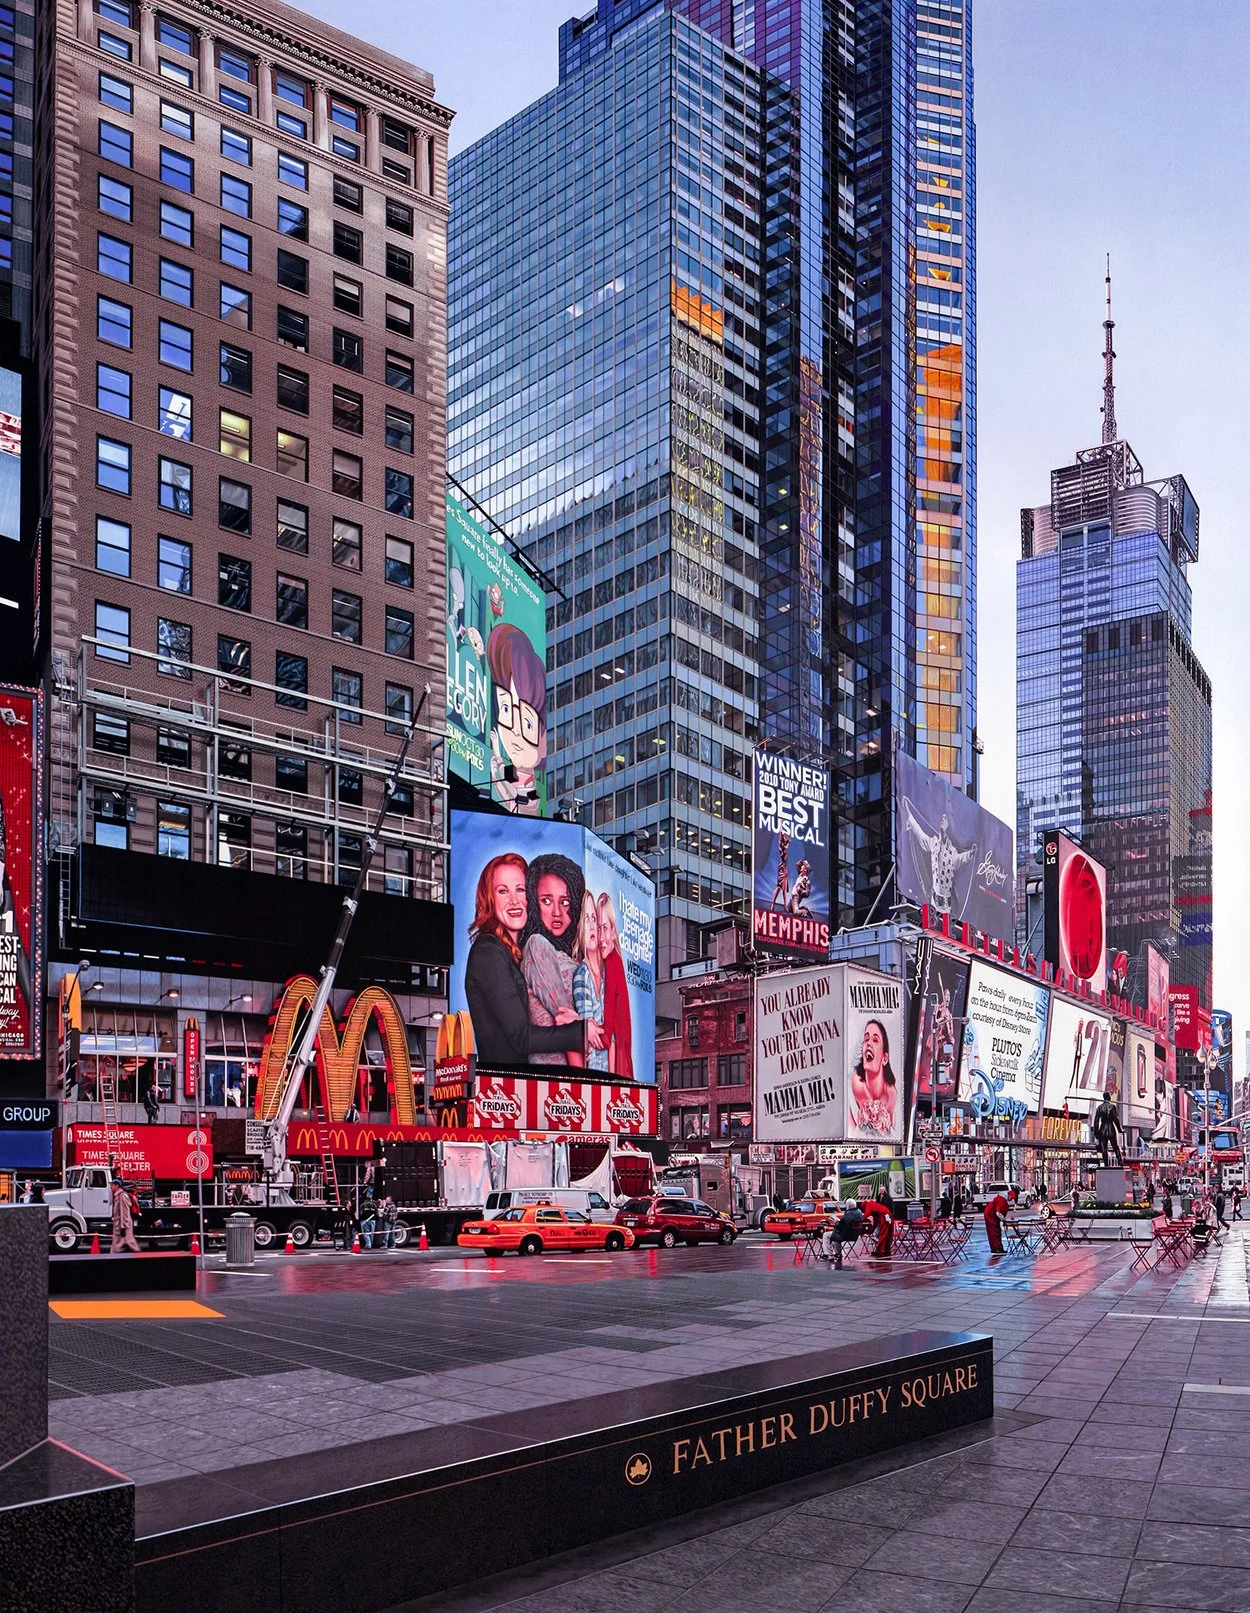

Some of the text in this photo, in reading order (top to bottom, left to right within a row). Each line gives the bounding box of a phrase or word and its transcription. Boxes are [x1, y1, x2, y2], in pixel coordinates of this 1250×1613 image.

[455, 509, 481, 543] Square
[482, 535, 502, 567] finally
[503, 556, 514, 577] has
[515, 574, 540, 606] someone
[461, 534, 475, 552] new
[477, 546, 485, 561] to
[486, 553, 501, 577] look
[502, 574, 511, 590] up
[446, 723, 461, 743] SUN
[755, 750, 828, 790] WINNER!
[758, 770, 824, 802] 2010 TONY AWARD
[758, 784, 824, 829] BEST
[758, 812, 824, 847] MUSICAL
[1046, 857, 1056, 865] LG
[622, 898, 640, 921] hate
[640, 909, 652, 928] my
[623, 912, 653, 950] teenage
[754, 909, 830, 947] MEMPHIS
[619, 932, 653, 965] daughter
[627, 958, 641, 977] WED
[761, 976, 831, 1016] YOU ALREADY
[849, 985, 900, 1009] MAMMA MIA!
[971, 997, 979, 1005] on
[979, 996, 989, 1007] the
[988, 1000, 1001, 1013] hour
[1001, 1003, 1014, 1016] from
[978, 982, 1034, 1010] Paws daily every hour
[781, 1003, 814, 1031] KNOW
[972, 1012, 1031, 1035] courtesy of Disney Store
[761, 1018, 840, 1059] YOU'RE GONNA
[991, 1037, 1022, 1058] PLUTO'S
[435, 1064, 468, 1077] McDonald's
[780, 1044, 825, 1075] LOVE IT!
[990, 1054, 1019, 1071] Sidewalk
[188, 1063, 196, 1093] HOURS
[990, 1067, 1016, 1083] Cinema
[763, 1085, 806, 1117] MAMMA
[808, 1077, 835, 1106] MIA!
[3, 1106, 51, 1122] GROUP
[1041, 1116, 1082, 1141] FOREVER
[77, 1130, 135, 1140] TIMES SQUARE
[82, 1151, 145, 1160] TIMES SQUARE
[672, 1364, 979, 1475] FATHER DUFFY SQUARE
